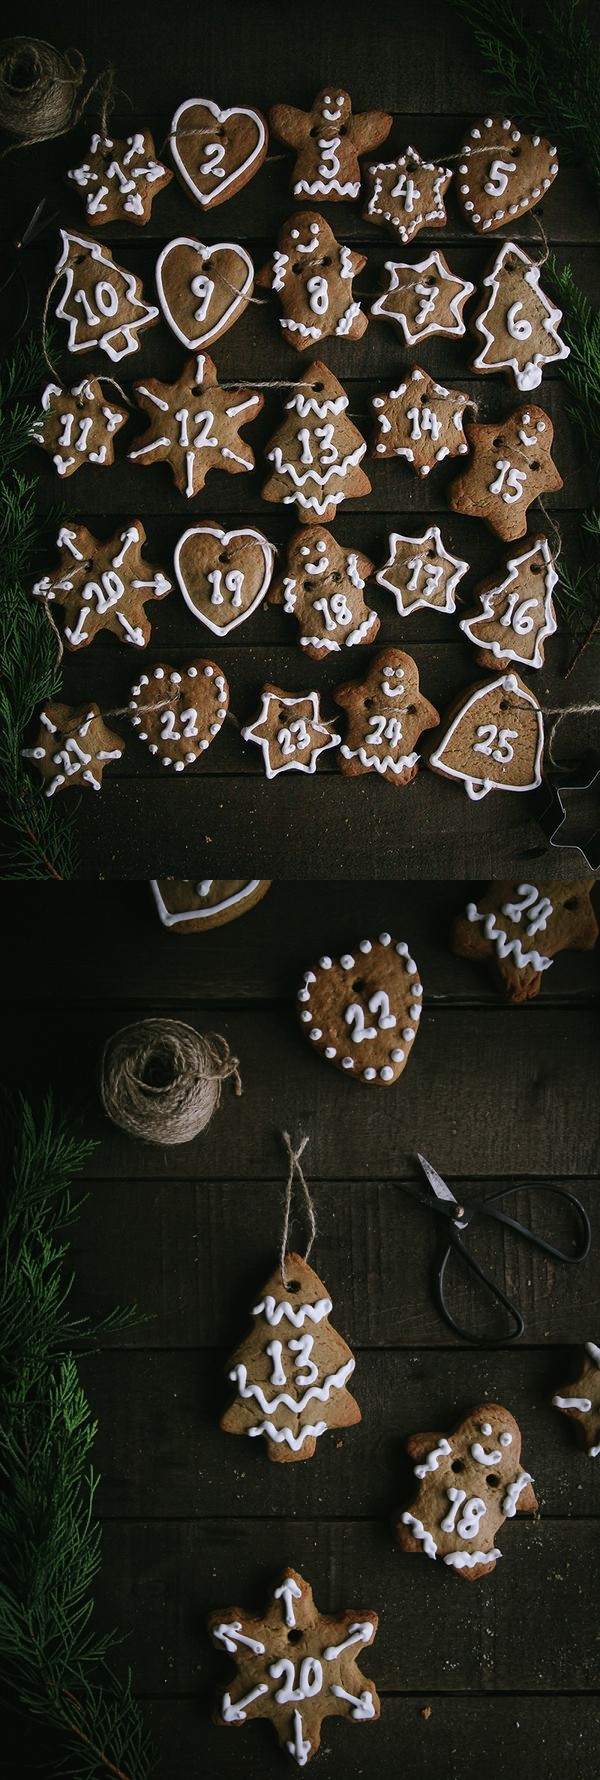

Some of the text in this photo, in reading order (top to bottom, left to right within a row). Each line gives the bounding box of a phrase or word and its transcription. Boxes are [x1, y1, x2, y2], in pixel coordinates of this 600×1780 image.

[199, 143, 226, 178] 2
[318, 137, 342, 179] 3
[391, 174, 422, 213] 4
[485, 160, 517, 197] 5
[74, 281, 119, 327] 10
[191, 275, 215, 322] 9
[307, 275, 330, 316] 8
[415, 285, 440, 325] 7
[508, 301, 532, 341] 6
[58, 413, 94, 452] 11
[175, 408, 219, 449] 12
[407, 406, 440, 441] 14
[298, 423, 339, 465] 13
[490, 460, 528, 505] 15
[82, 571, 125, 614] 20
[207, 569, 245, 608] 19
[407, 557, 444, 597] 17
[314, 593, 354, 632] 18
[501, 592, 538, 635] 16
[160, 707, 199, 741] 22
[277, 717, 312, 757] 23
[366, 715, 404, 749] 24
[473, 724, 518, 764] 25
[501, 883, 554, 937] 24
[345, 990, 397, 1044] 22
[266, 1333, 319, 1386] 13
[442, 1487, 487, 1541] 18
[270, 1656, 324, 1705] 20
